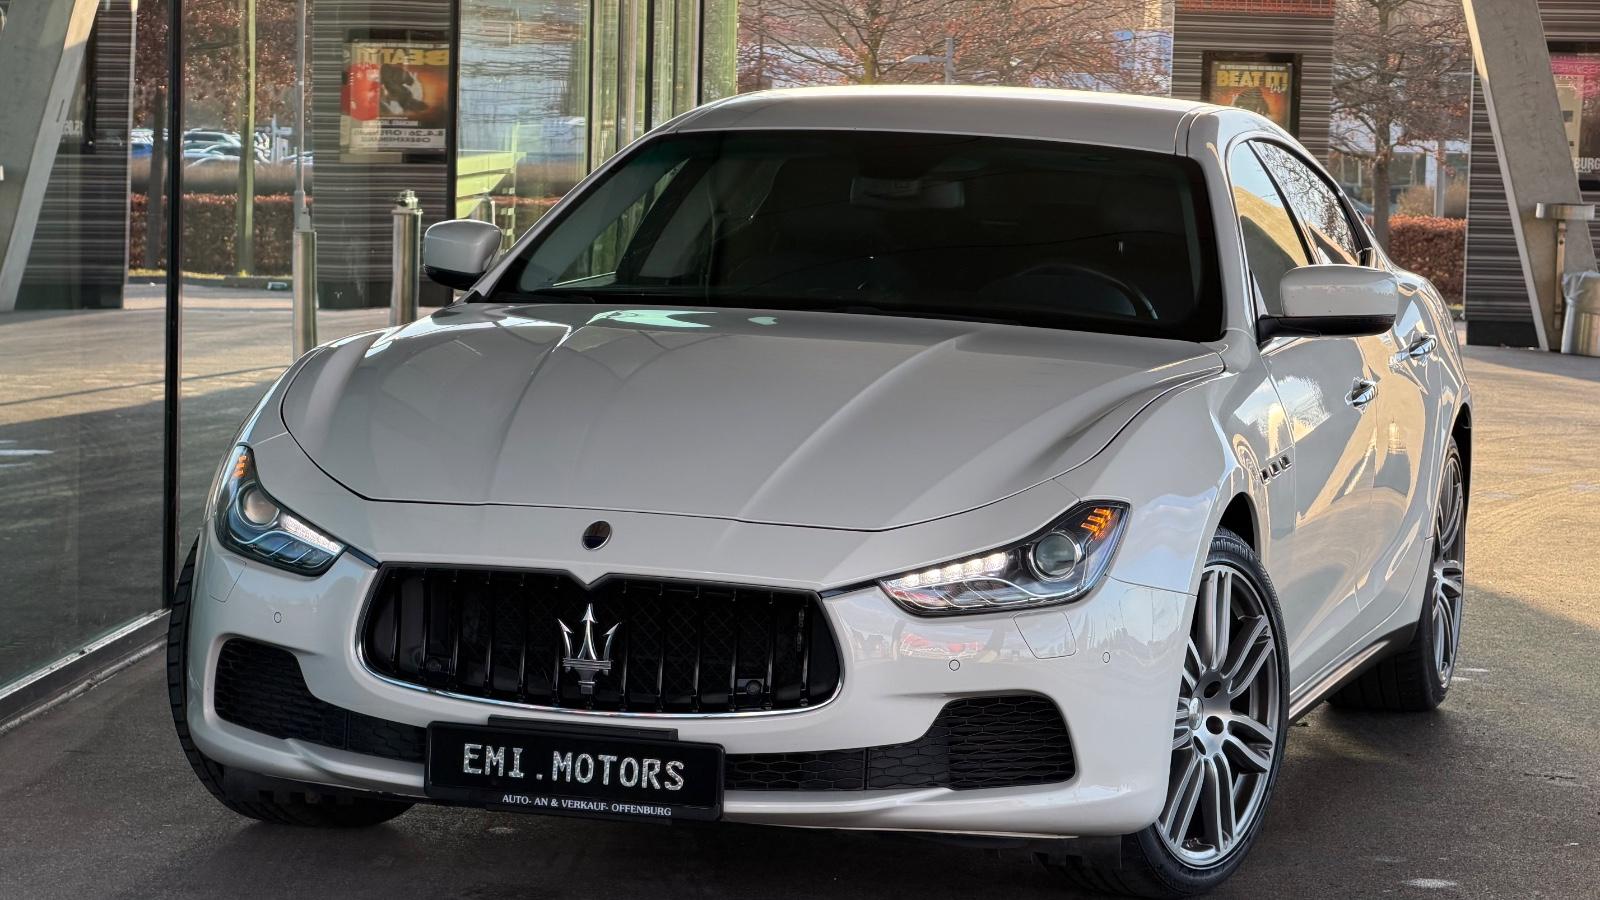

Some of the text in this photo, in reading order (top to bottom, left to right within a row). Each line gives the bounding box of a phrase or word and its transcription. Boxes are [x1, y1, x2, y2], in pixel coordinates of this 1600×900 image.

[1216, 70, 1288, 90] BEAT IT!
[1210, 538, 1248, 560] ontinental
[502, 794, 672, 816] AUTO- AN & VERKAUF- OFFENBURG
